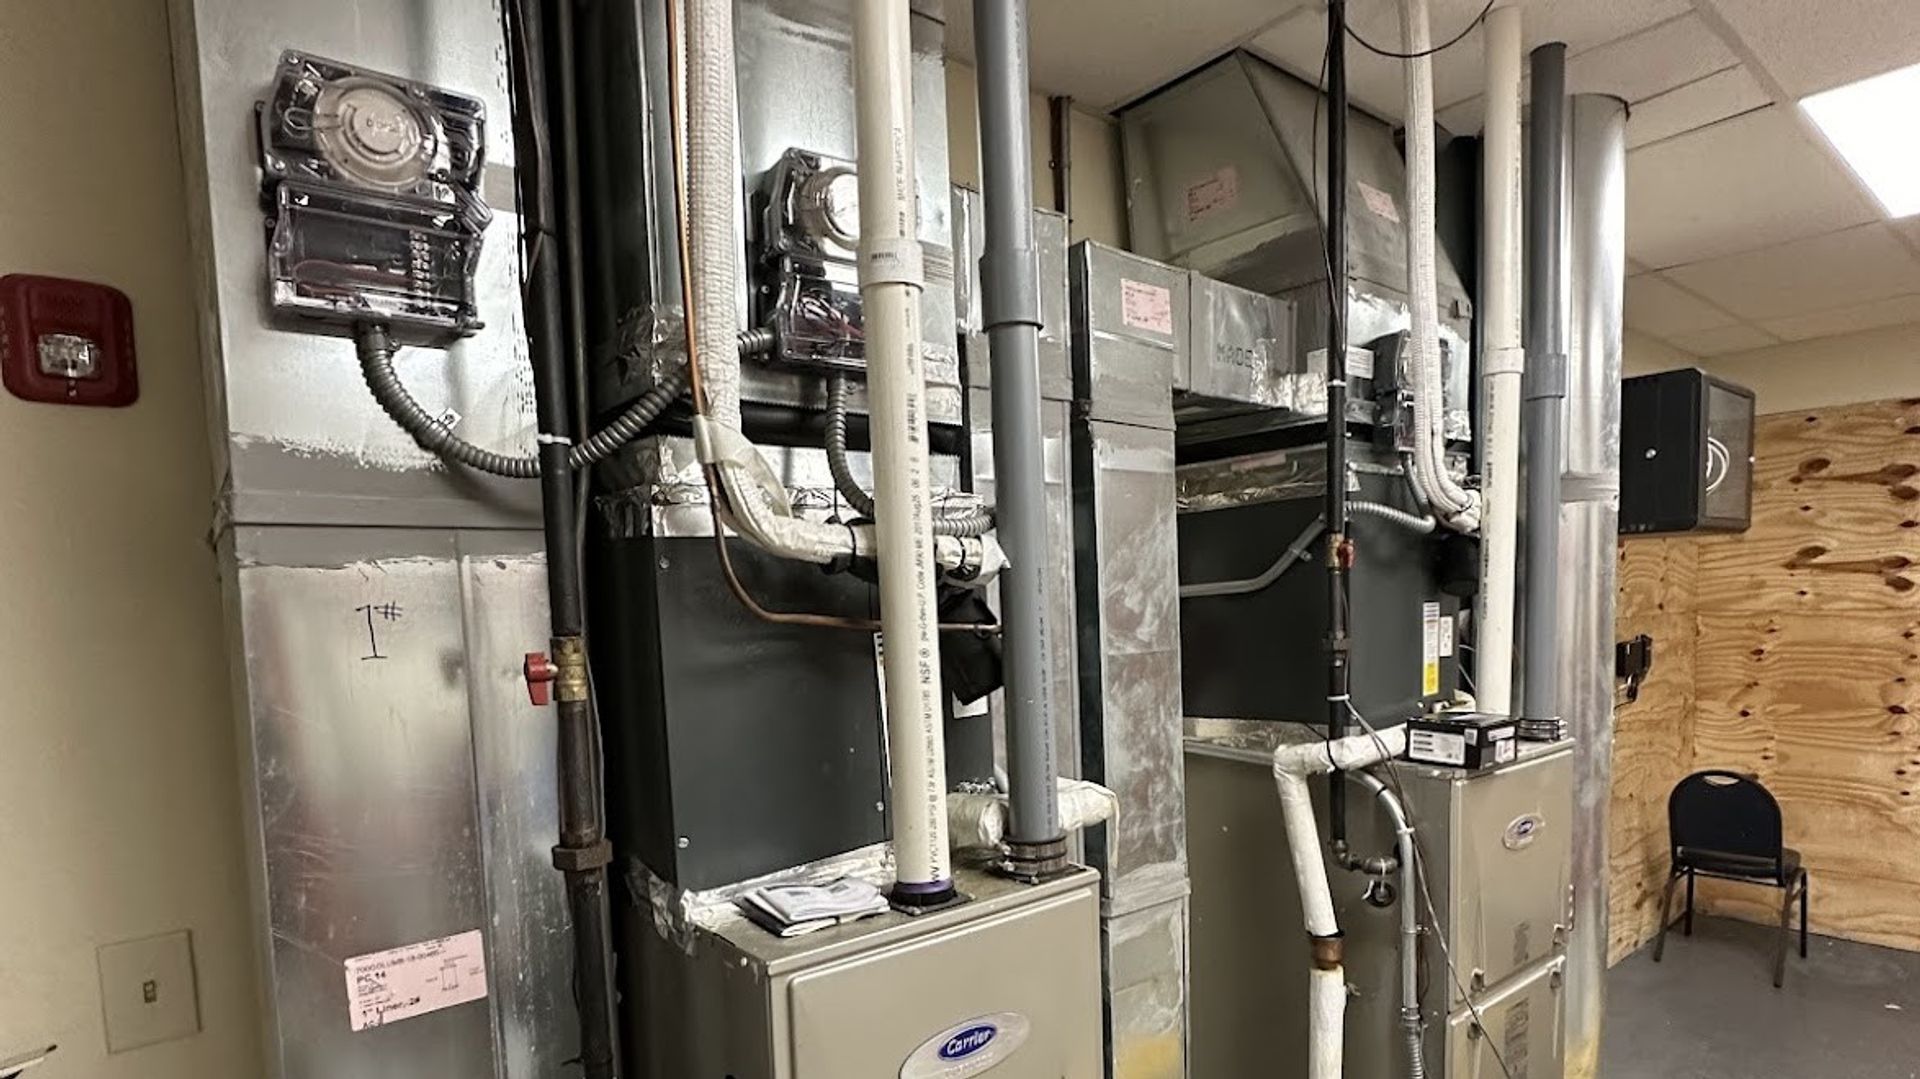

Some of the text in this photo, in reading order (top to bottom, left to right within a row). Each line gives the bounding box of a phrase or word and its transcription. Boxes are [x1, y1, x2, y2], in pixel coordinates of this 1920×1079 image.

[355, 601, 403, 661] 1#
[919, 660, 932, 684] NSF
[946, 1029, 992, 1056] Carrier
